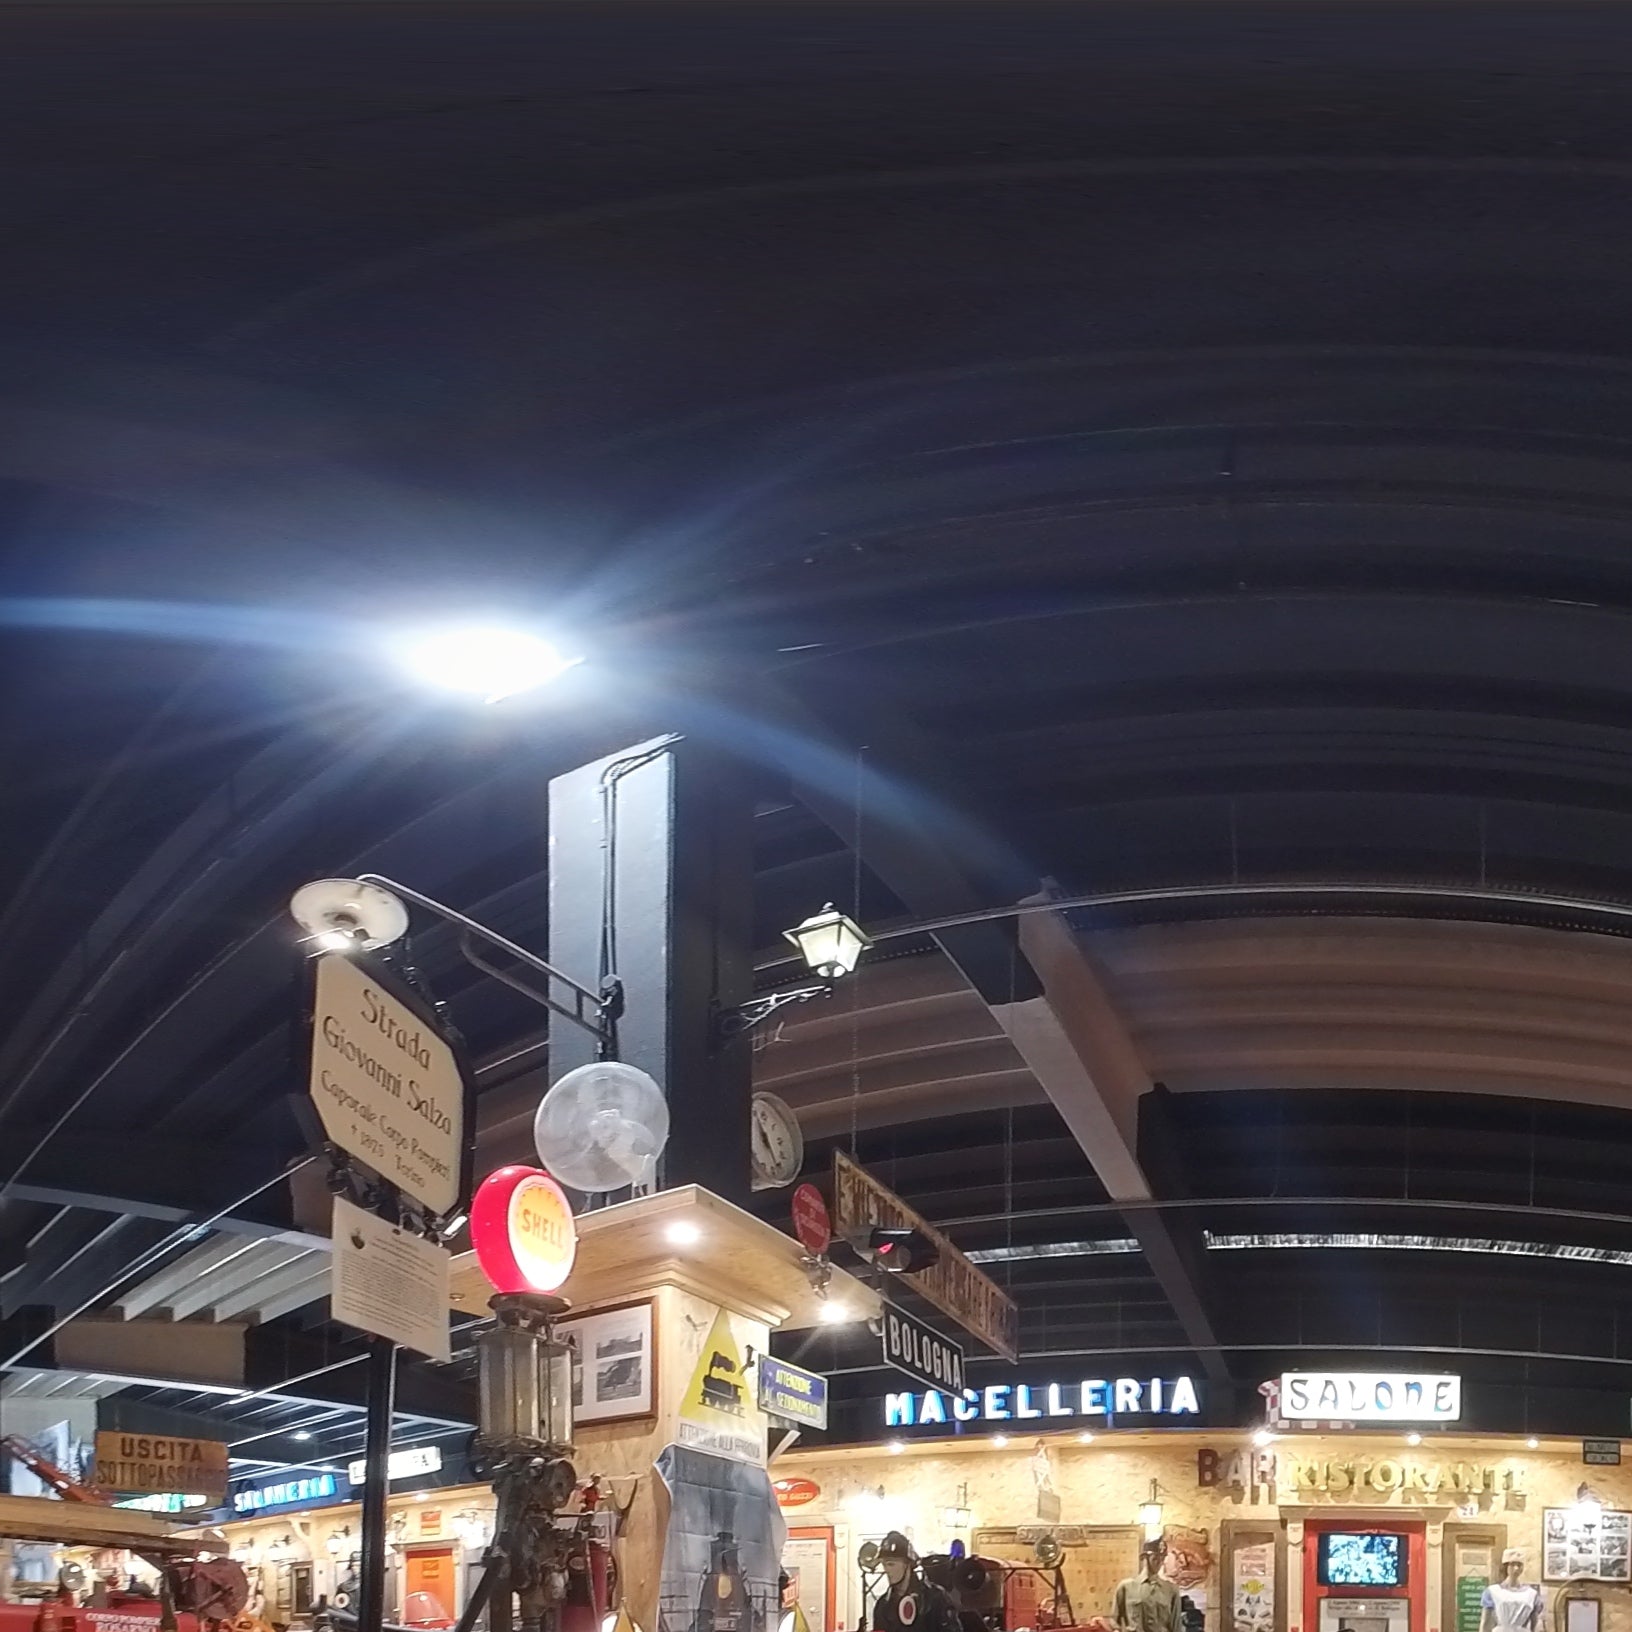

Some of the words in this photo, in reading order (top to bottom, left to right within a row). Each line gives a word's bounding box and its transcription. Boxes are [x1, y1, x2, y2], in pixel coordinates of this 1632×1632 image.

[361, 988, 431, 1071] Strada
[323, 1016, 402, 1098] Giovanni
[407, 1080, 452, 1135] Salza
[522, 1209, 563, 1249] SHELL
[889, 1314, 962, 1391] BOLOGNA
[884, 1375, 1201, 1426] MACELLERIA
[1289, 1379, 1456, 1413] SALONE
[120, 1437, 203, 1462] USCITA
[1198, 1448, 1277, 1487] BAR
[1288, 1459, 1531, 1493] RISTORANTE
